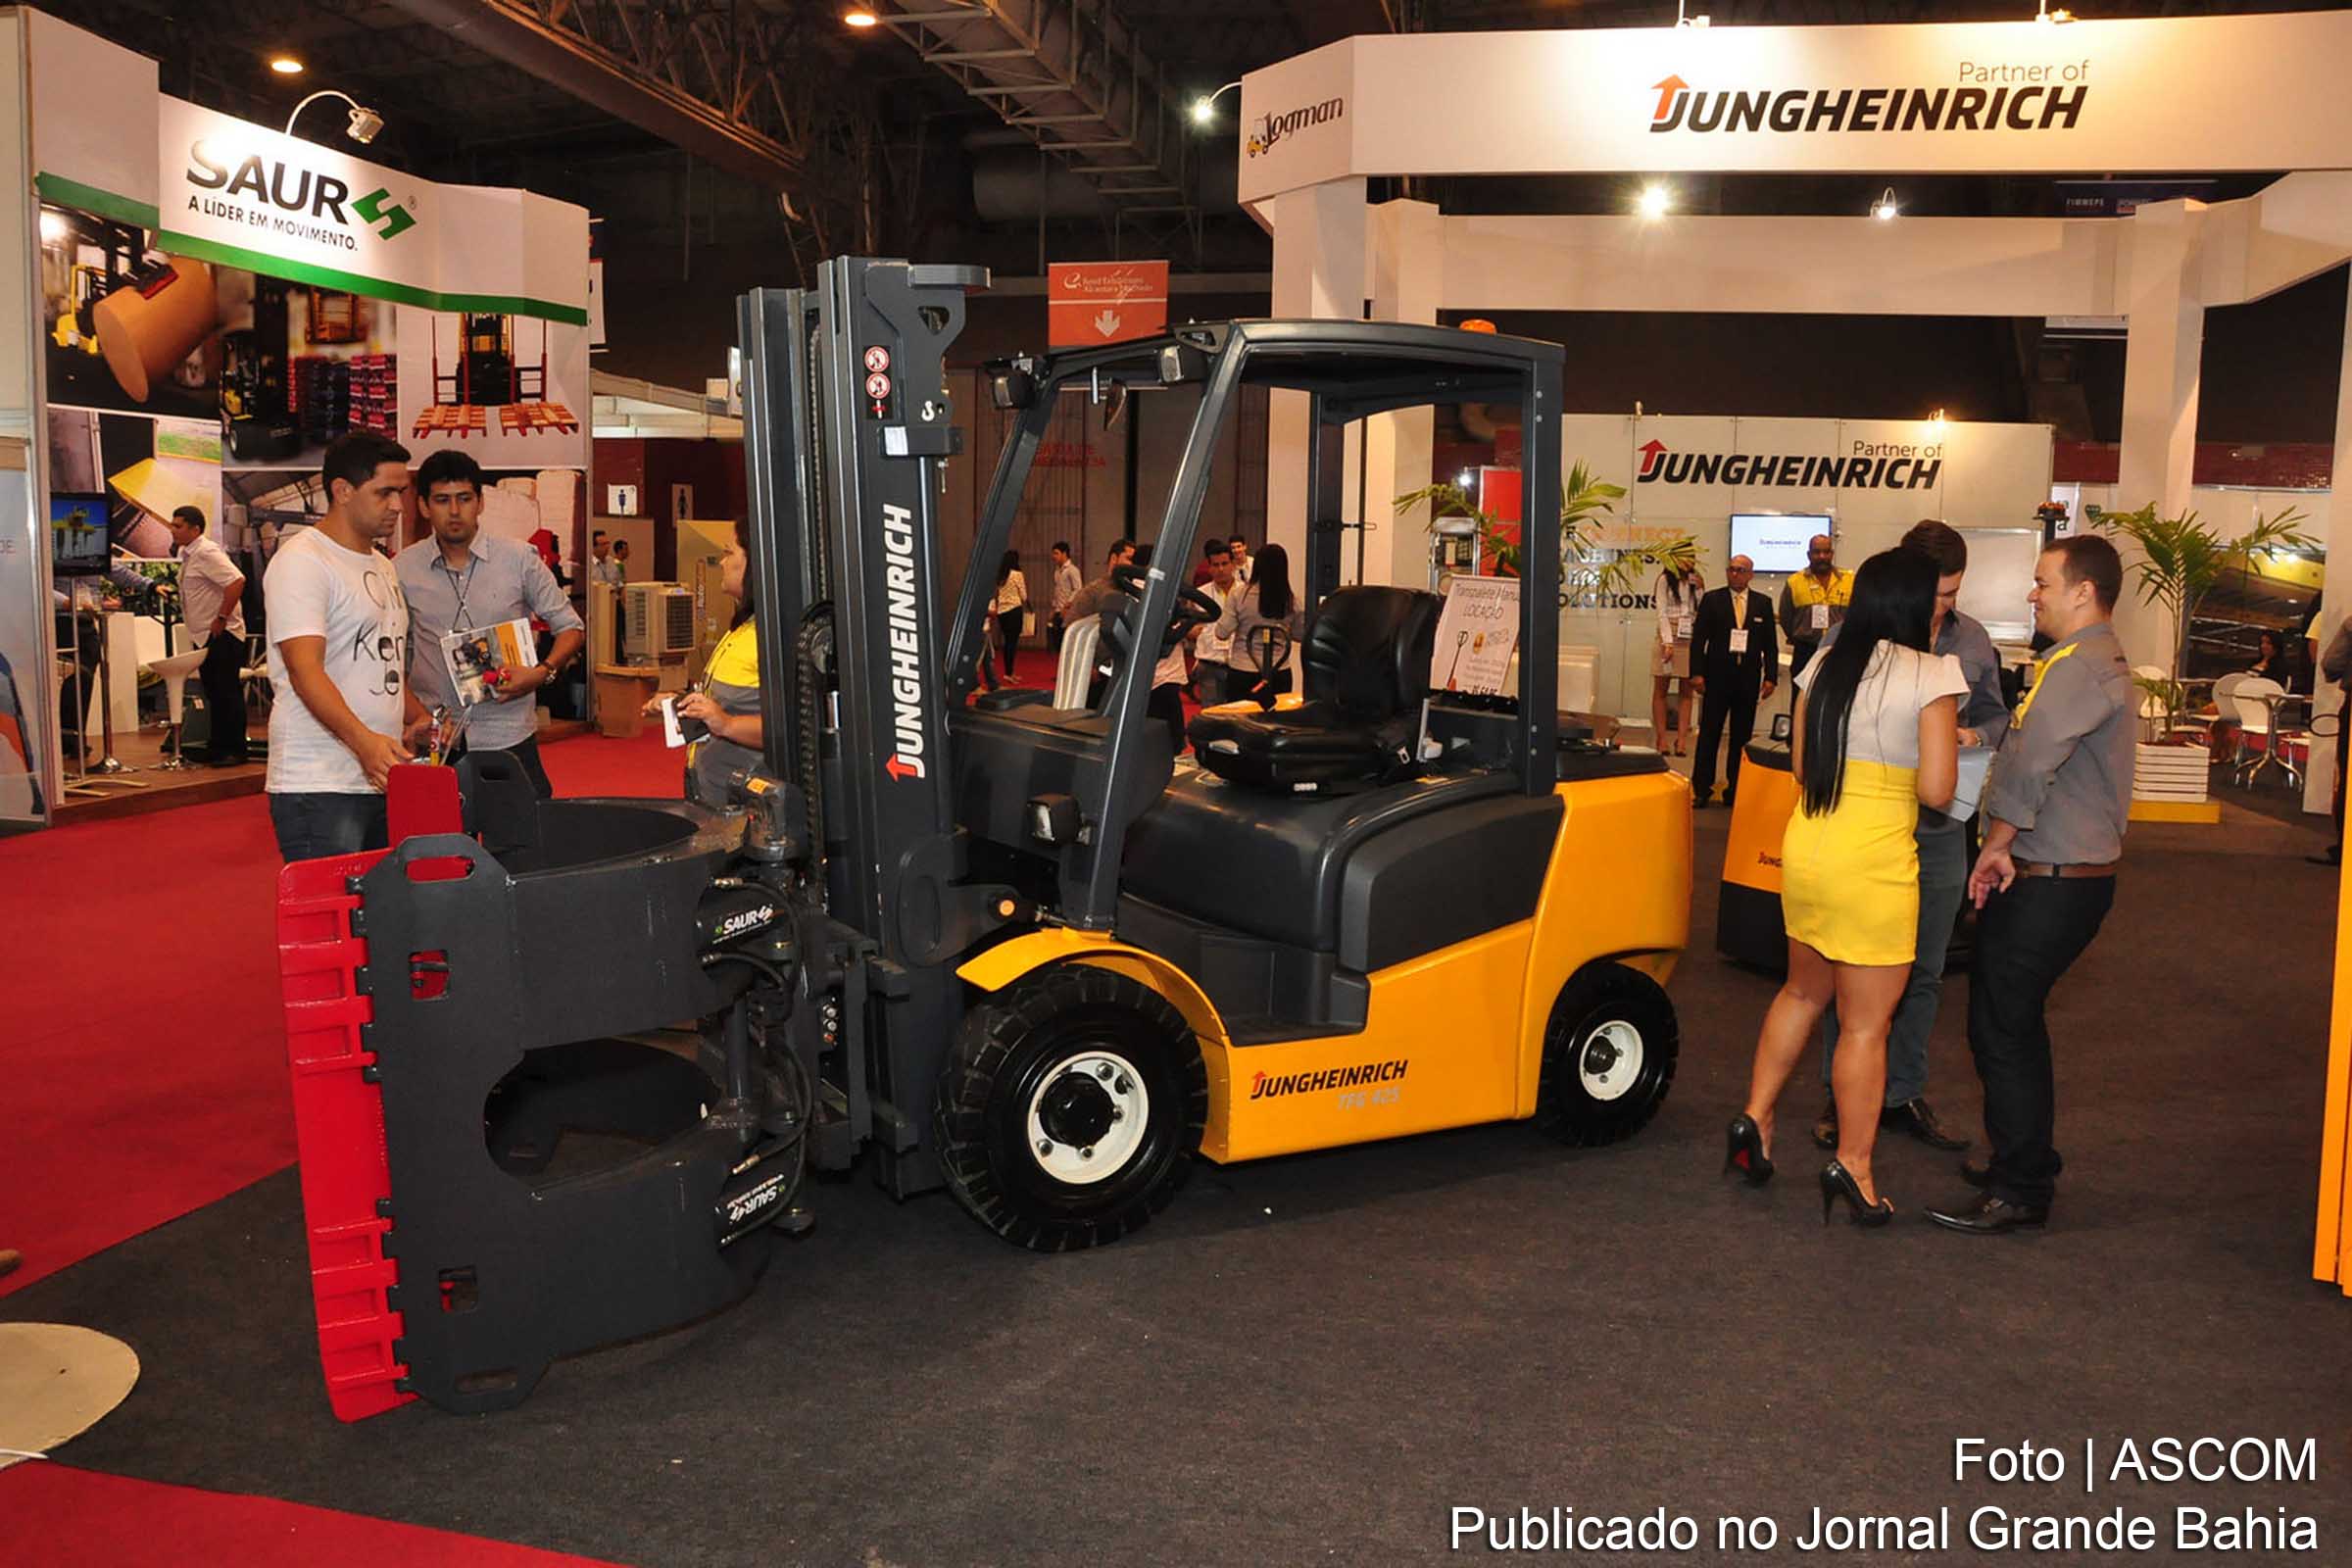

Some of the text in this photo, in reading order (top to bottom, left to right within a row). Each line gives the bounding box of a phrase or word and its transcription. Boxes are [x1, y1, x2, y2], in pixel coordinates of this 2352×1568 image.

[1958, 60, 2091, 83] Partner of
[1264, 97, 1344, 148] Logman
[1648, 85, 2089, 133] JUNGHEINRICH
[186, 139, 350, 226] SAUR
[187, 195, 359, 252] A LÍDER EM MOVIMENTO.
[1853, 440, 1943, 459] Partner of
[1637, 453, 1941, 489] JUNGHEINRICH
[1558, 593, 1657, 610] OLUTIONS
[883, 503, 926, 778] JUNGHEINRICH
[723, 909, 759, 935] SAUR
[1250, 1059, 1408, 1101] JUNGHEINRICH
[745, 1185, 777, 1215] SAUR
